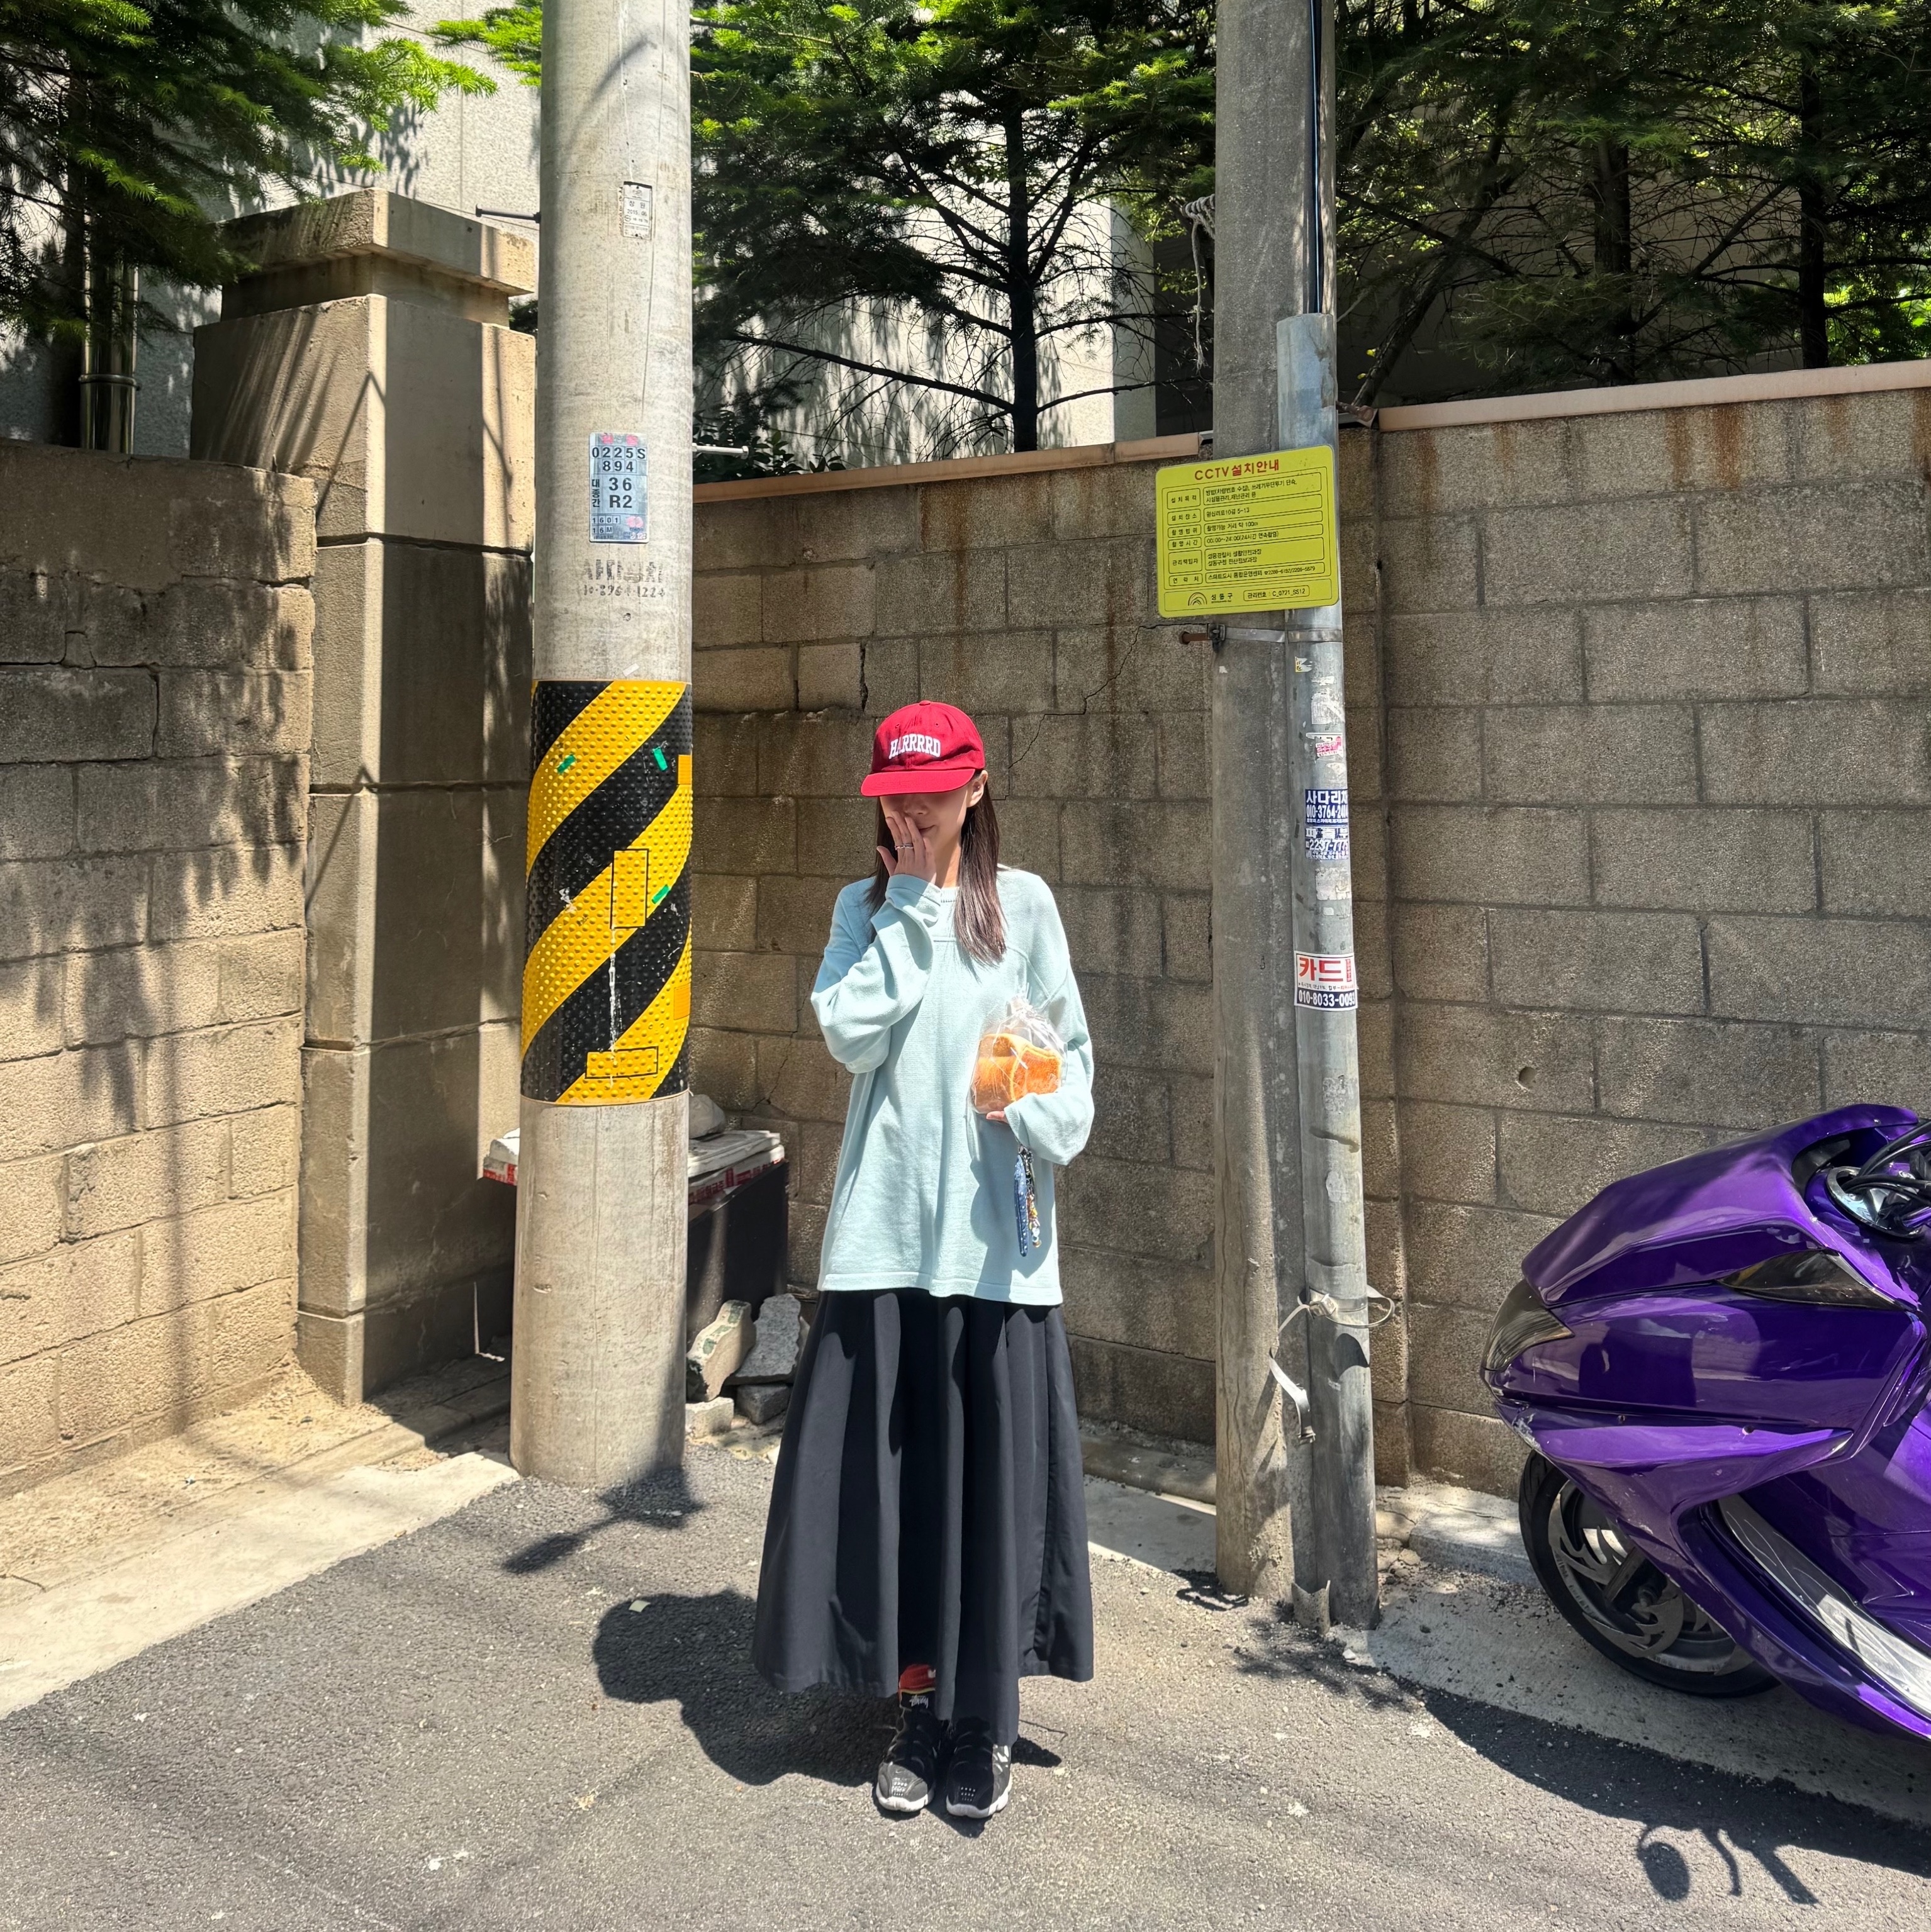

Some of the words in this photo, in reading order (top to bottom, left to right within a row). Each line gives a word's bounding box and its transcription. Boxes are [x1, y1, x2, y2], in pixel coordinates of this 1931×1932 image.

[591, 447, 646, 459] 0225S
[602, 460, 634, 472] 894
[609, 477, 632, 491] 36
[609, 494, 632, 508] R2
[888, 734, 941, 759] HARRRRD
